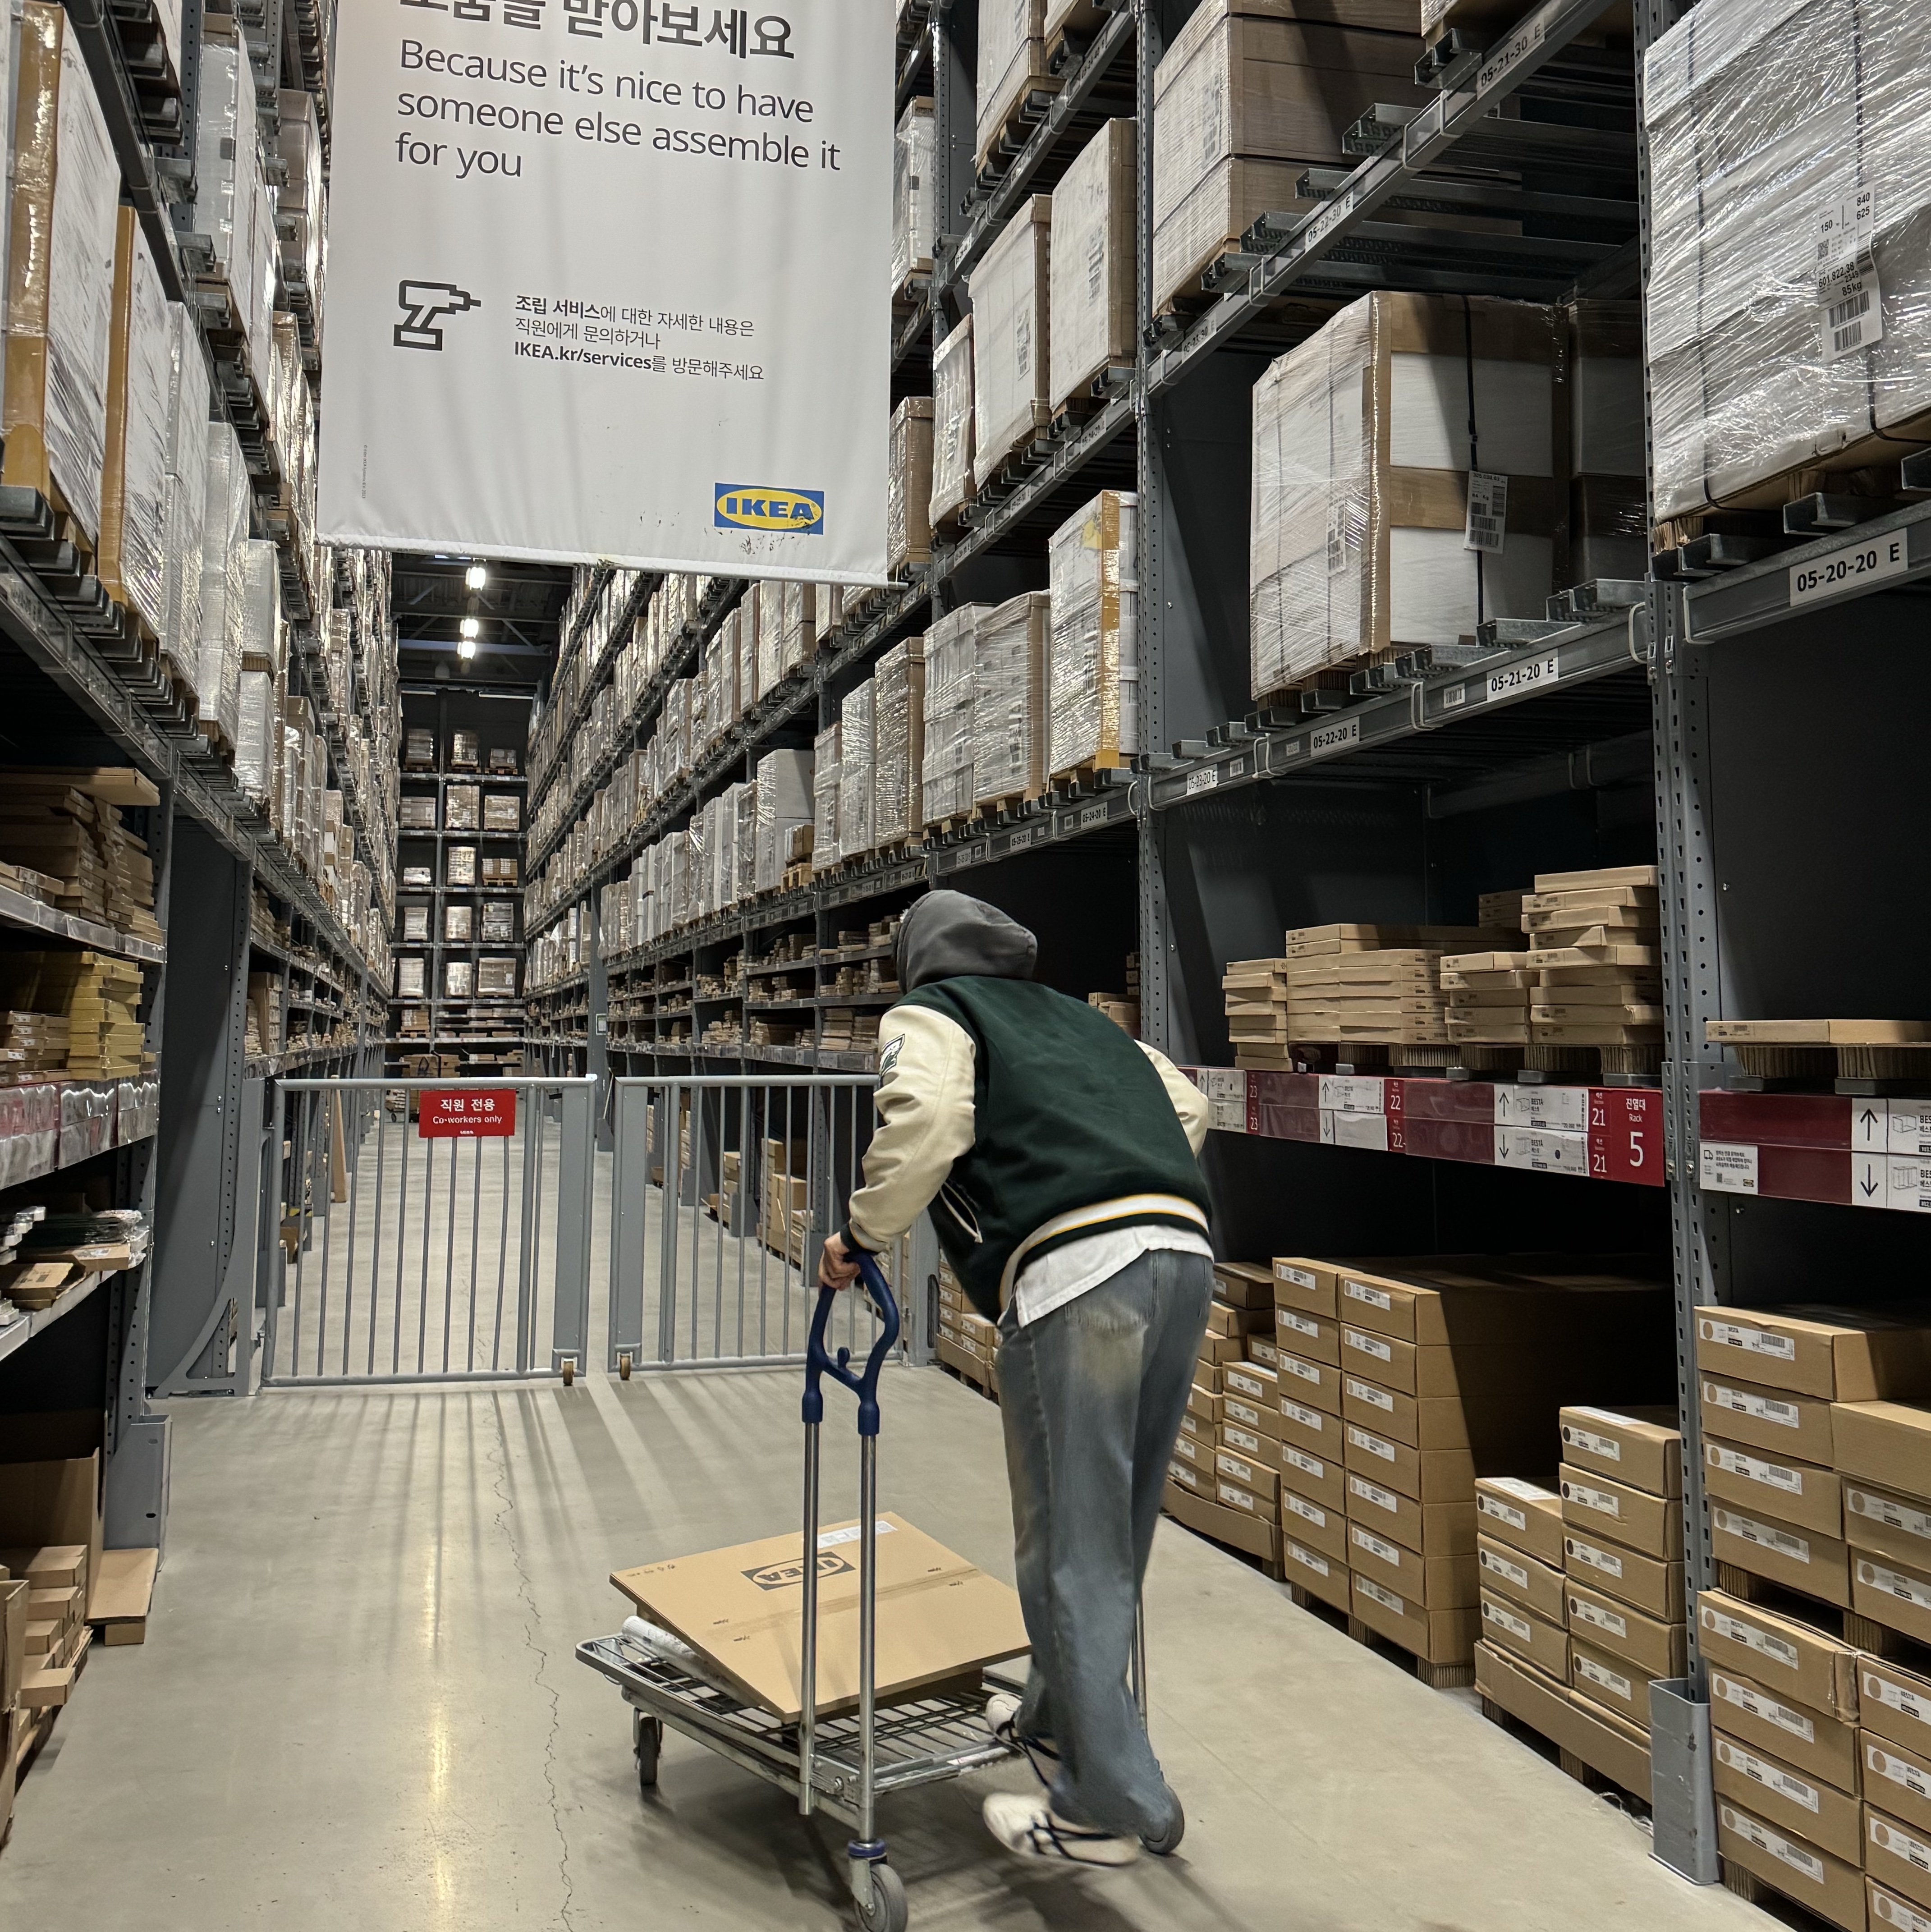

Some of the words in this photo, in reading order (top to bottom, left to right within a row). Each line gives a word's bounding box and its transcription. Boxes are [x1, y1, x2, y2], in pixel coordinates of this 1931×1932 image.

[564, 0, 794, 59] 받아보세요
[1481, 36, 1527, 87] 05-21-30
[1534, 23, 1541, 40] E
[401, 39, 547, 87] Because
[560, 60, 603, 95] it's
[616, 71, 682, 105] nice
[692, 82, 725, 110] to
[738, 84, 813, 123] have
[398, 93, 563, 135] someone
[575, 111, 641, 145] else
[652, 128, 809, 168] assemble
[821, 140, 840, 170] it
[395, 132, 448, 165] for
[456, 147, 521, 179] you
[1345, 196, 1350, 209] E
[1857, 193, 1870, 206] 840
[1856, 206, 1870, 220] 625
[1821, 220, 1833, 233] 150
[515, 295, 546, 315] 조립
[552, 299, 615, 323] 서비스에
[622, 307, 653, 326] 대한
[657, 312, 704, 331] 자세한
[709, 317, 754, 337] 내용은
[515, 317, 578, 340] 직원에게
[583, 326, 661, 350] 문의하거나
[515, 341, 667, 373] IKEA.kr/services를
[673, 358, 764, 381] 방문해주세요
[726, 497, 815, 520] IKEA
[1797, 550, 1877, 592] 05-20-20
[1889, 542, 1900, 562] E
[1491, 663, 1540, 693] 05-21-20
[1547, 659, 1554, 674] E
[1313, 727, 1347, 749] 05-22-20
[1352, 724, 1357, 737] E
[1212, 770, 1215, 781] E
[1250, 1085, 1257, 1097] 23
[440, 1099, 464, 1112] 직원
[471, 1098, 495, 1111] 전용
[1390, 1095, 1401, 1110] 22
[433, 1116, 482, 1124] Co-workers
[484, 1115, 502, 1124] only
[1250, 1117, 1258, 1130] 23
[1592, 1108, 1605, 1126] 21
[1629, 1113, 1642, 1122] Rack
[1392, 1132, 1403, 1147] 22
[1630, 1131, 1643, 1167] 5
[1593, 1154, 1607, 1172] 21
